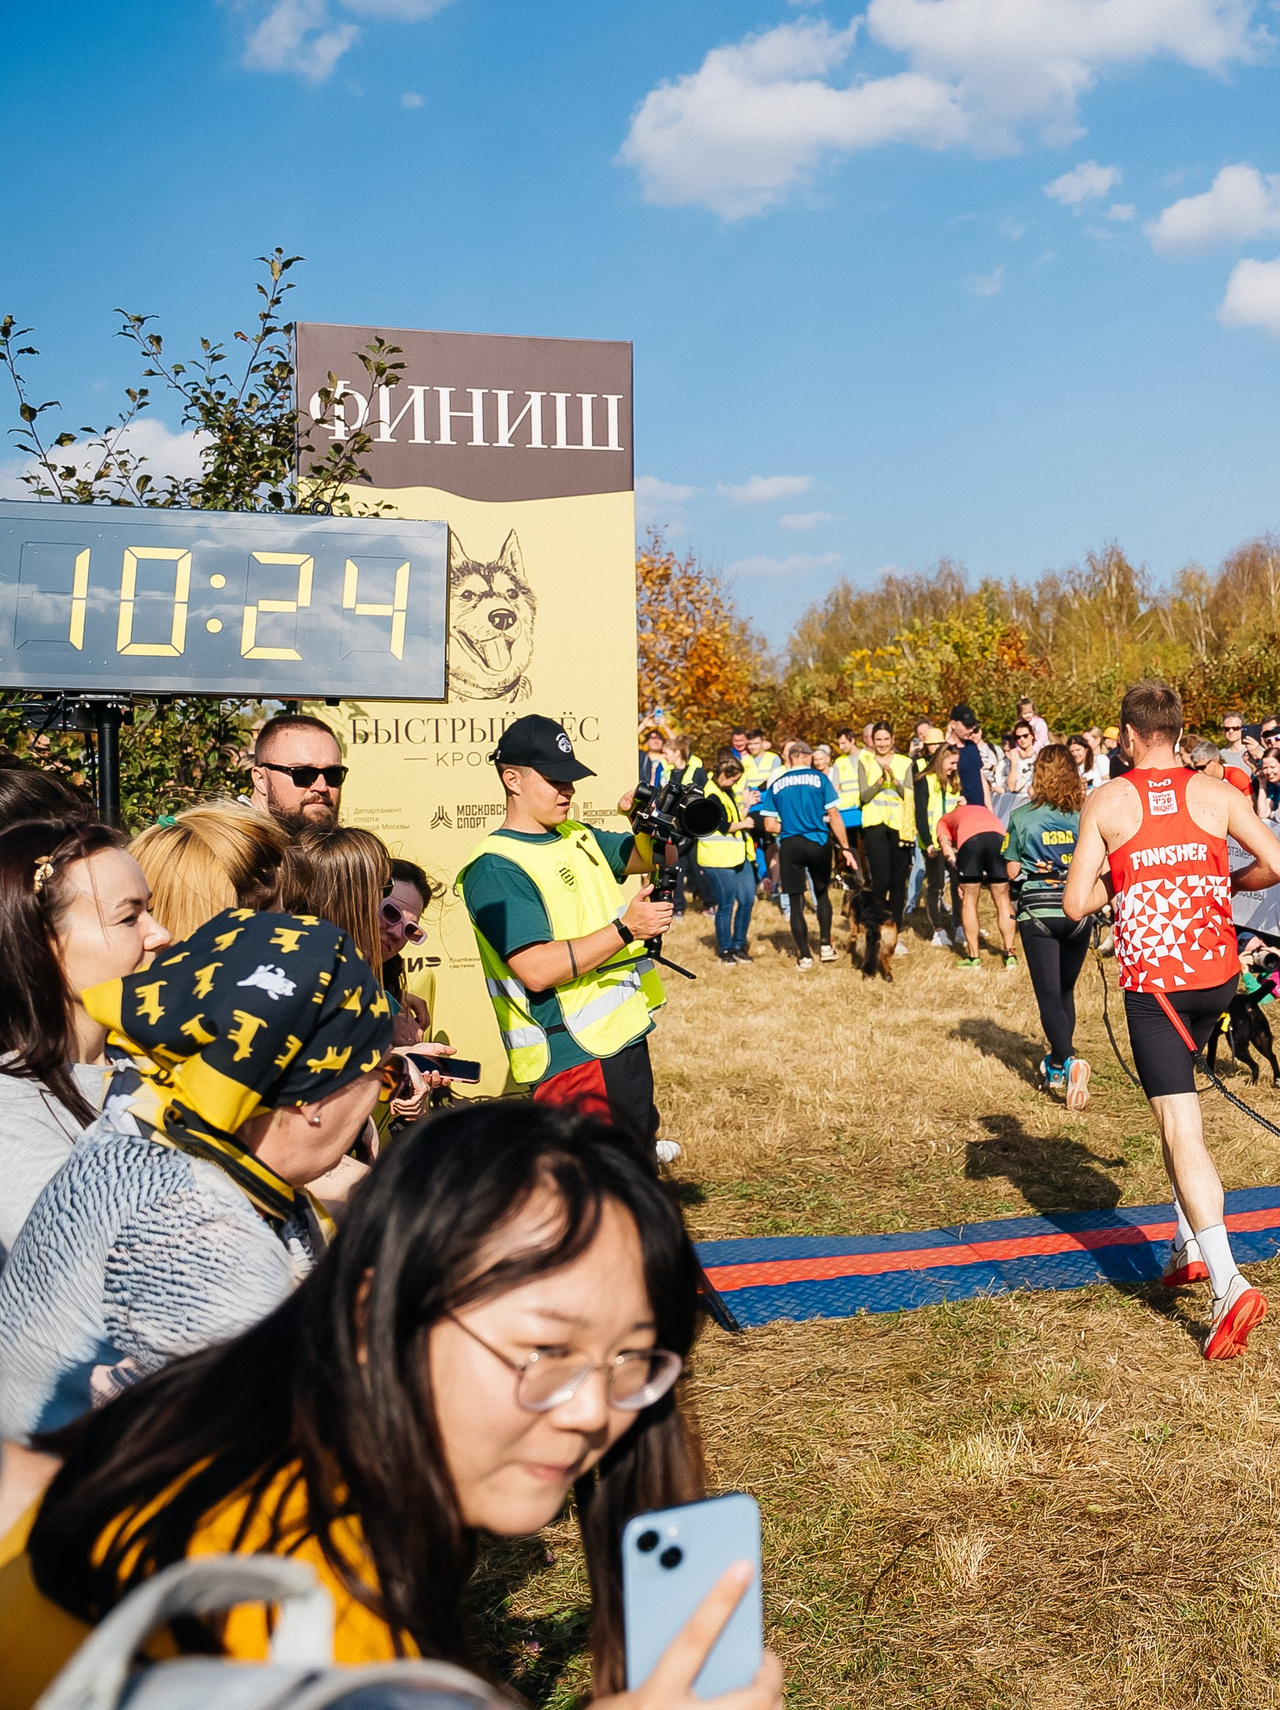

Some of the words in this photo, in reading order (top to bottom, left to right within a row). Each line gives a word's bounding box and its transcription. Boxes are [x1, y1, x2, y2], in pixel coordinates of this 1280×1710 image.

[309, 380, 625, 451] ФИНИШ
[69, 546, 411, 661] 10:24
[556, 711, 600, 743] ЁС
[436, 752, 496, 767] КРОС
[772, 774, 822, 795] RUNNING
[354, 816, 379, 824] спорта
[457, 817, 487, 829] СПОРТ
[1129, 842, 1208, 871] FINISHER
